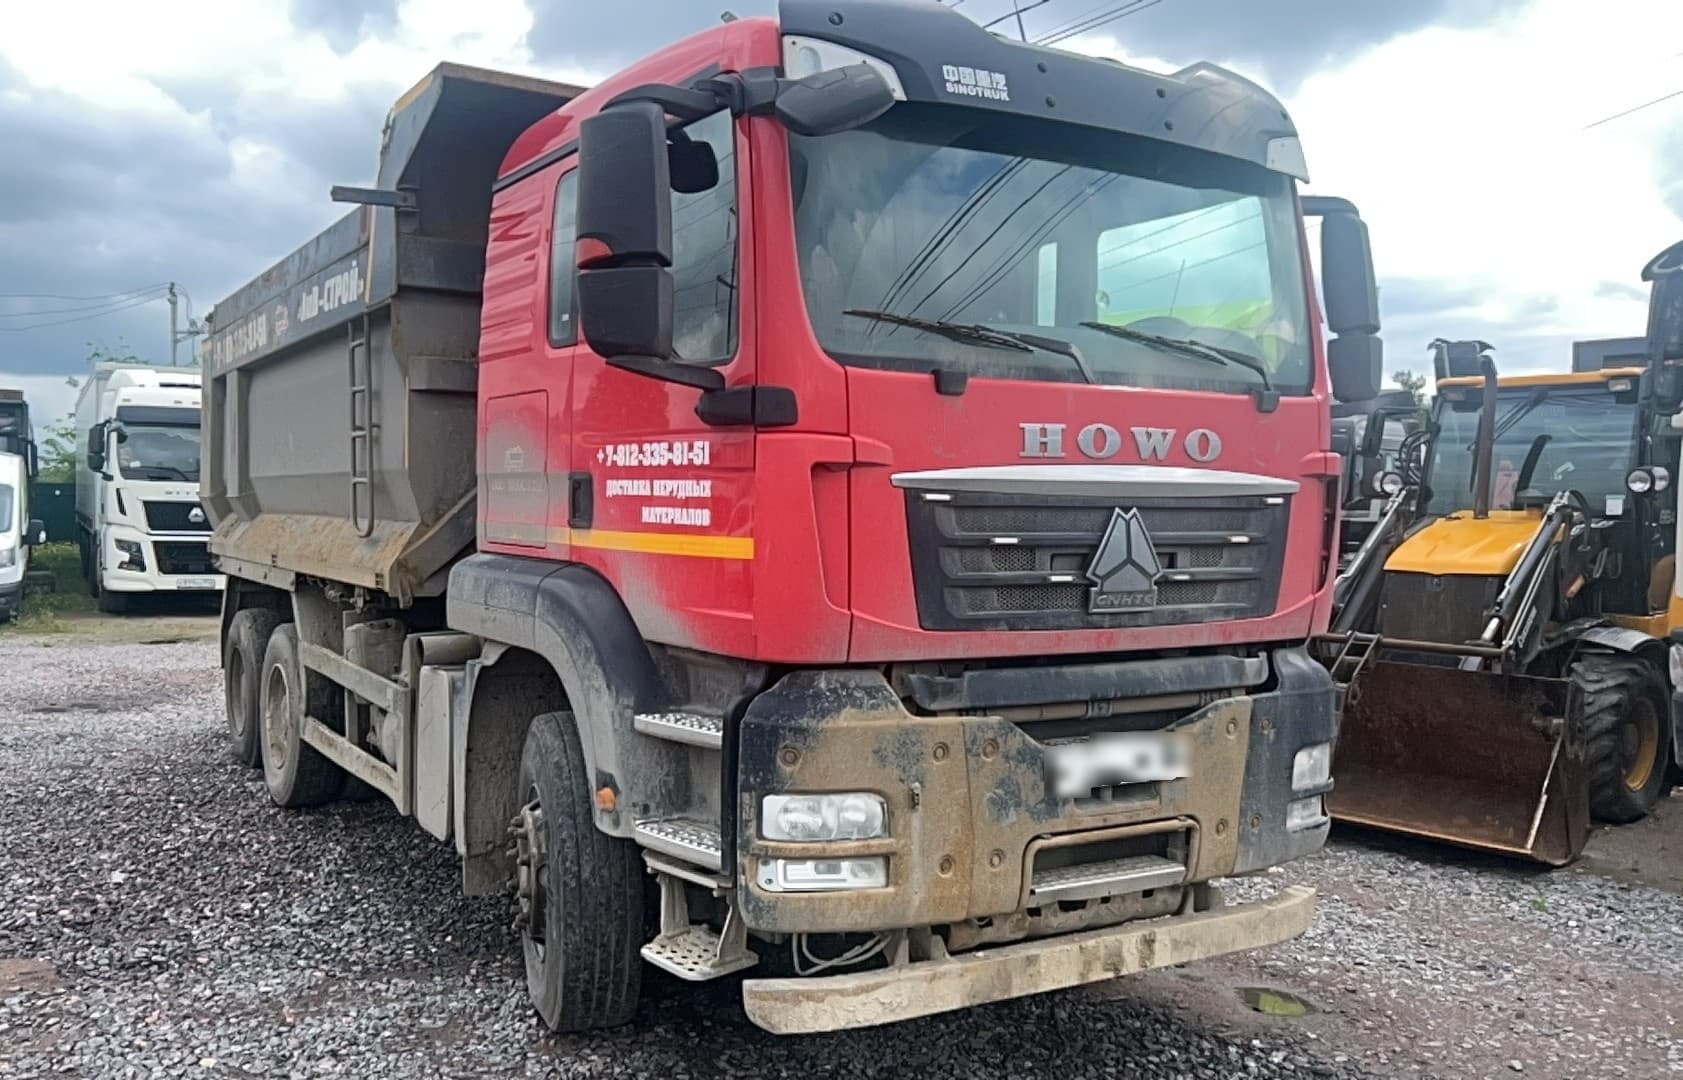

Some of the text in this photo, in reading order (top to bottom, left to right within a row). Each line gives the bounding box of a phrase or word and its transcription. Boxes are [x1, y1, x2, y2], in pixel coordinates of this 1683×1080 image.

[945, 81, 1011, 101] SINOTRUK
[1019, 423, 1223, 462] HOWO
[641, 506, 711, 527] МАТЕРИАЛОВ
